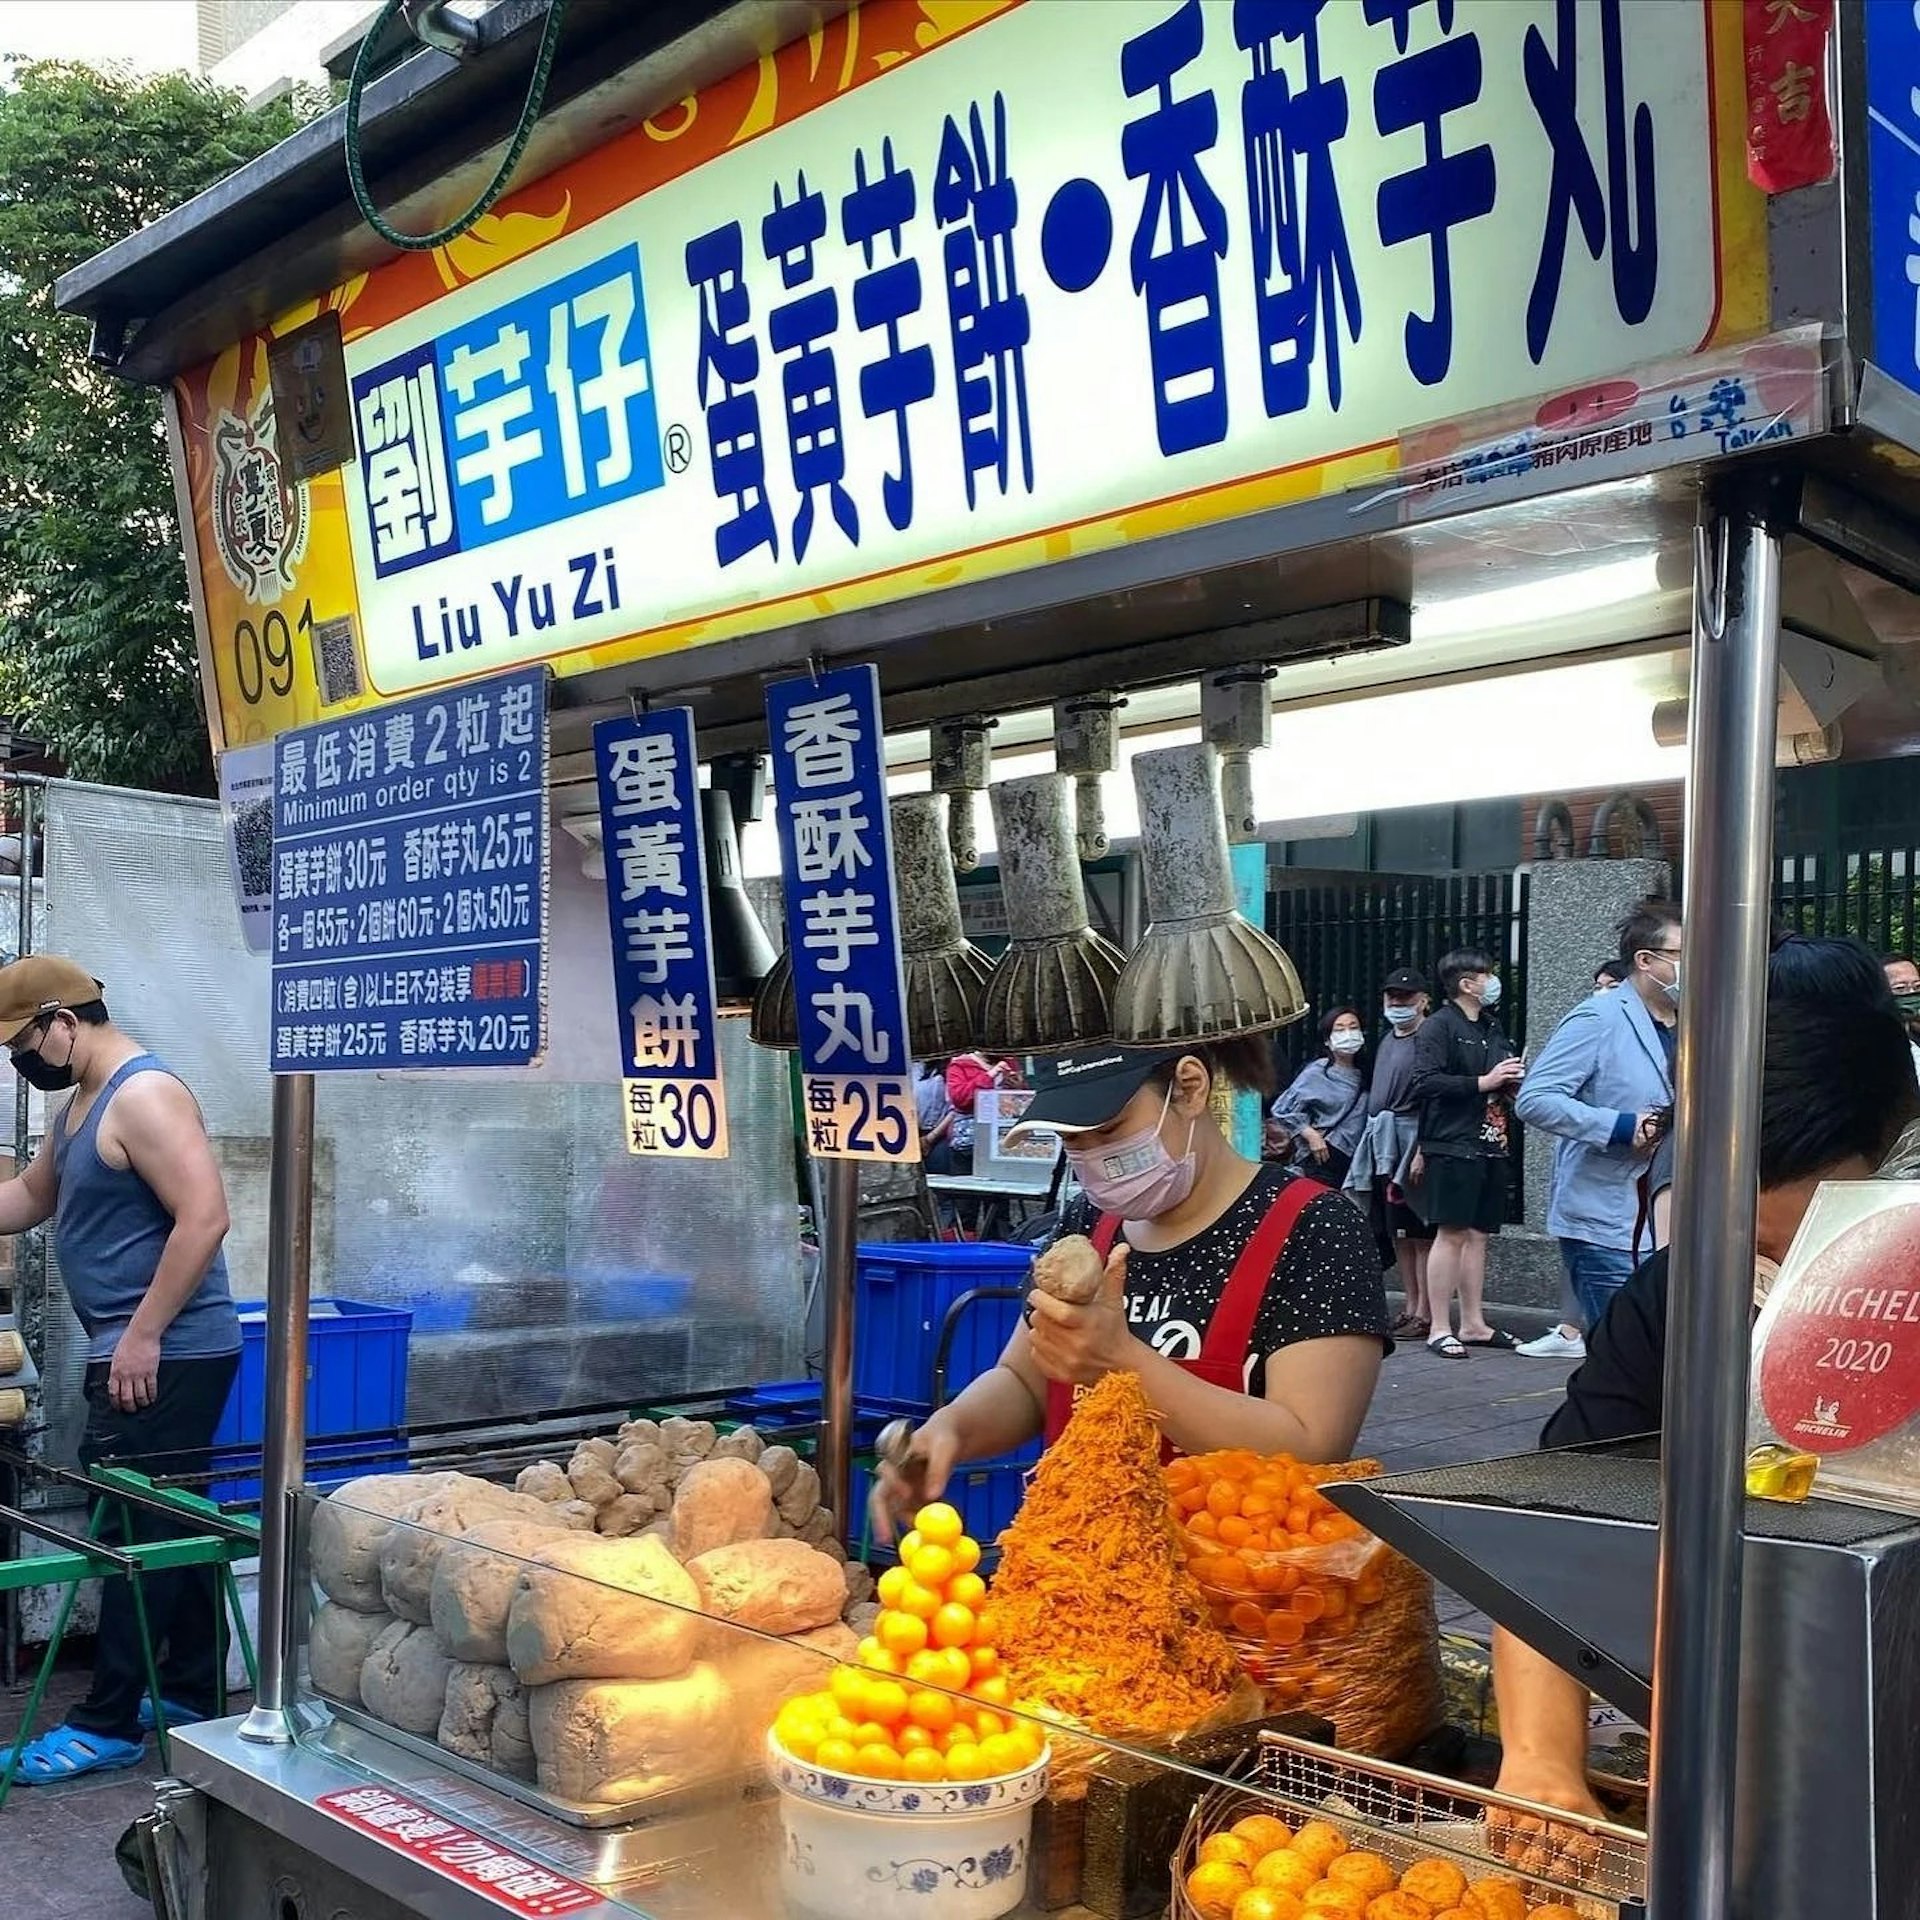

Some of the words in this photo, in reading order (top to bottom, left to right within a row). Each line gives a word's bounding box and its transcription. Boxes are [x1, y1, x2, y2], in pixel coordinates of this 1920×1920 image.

[358, 272, 649, 566] 劉芋仔
[411, 597, 482, 661] Liu
[491, 573, 555, 638] Yu
[567, 547, 621, 620] Zi
[283, 789, 368, 827] Minimum
[375, 774, 435, 808] order
[443, 764, 480, 800] qty
[489, 757, 509, 785] is
[517, 750, 532, 782] 2
[607, 731, 701, 1069] 蛋黃芋餅
[784, 692, 890, 1065] 香酥芋丸
[629, 1082, 658, 1151] 每粒
[659, 1081, 717, 1150] 30
[806, 1079, 839, 1152] 每粒
[841, 1080, 908, 1155] 25
[1816, 1338, 1892, 1373] 2020
[1793, 1422, 1850, 1438] MICHELIN
